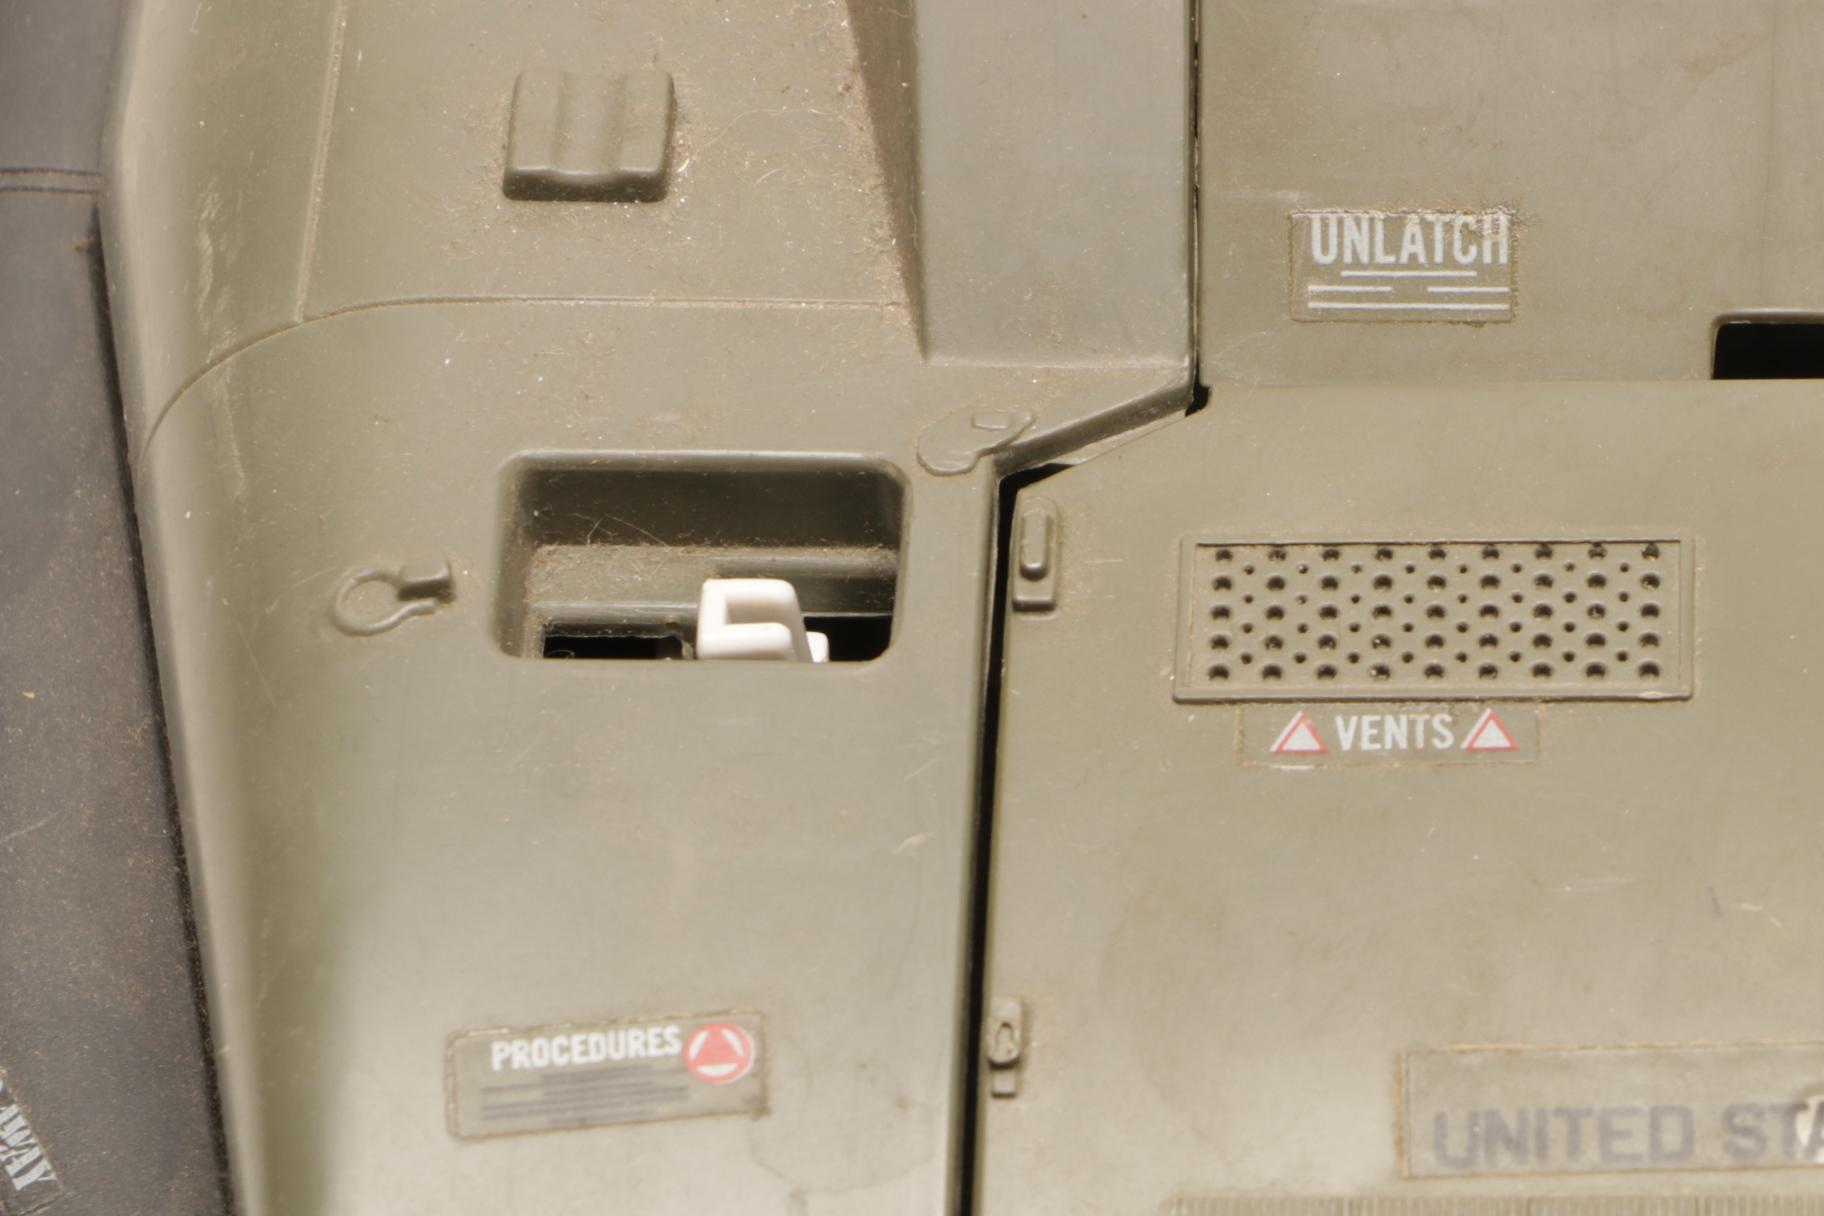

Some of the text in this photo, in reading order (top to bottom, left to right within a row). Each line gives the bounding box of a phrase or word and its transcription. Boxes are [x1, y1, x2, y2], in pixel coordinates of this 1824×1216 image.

[1310, 212, 1509, 265] UNLATCH
[1335, 713, 1455, 751] VENTS
[490, 1025, 683, 1072] PROCEDURES
[1433, 1103, 1695, 1169] UNITED
